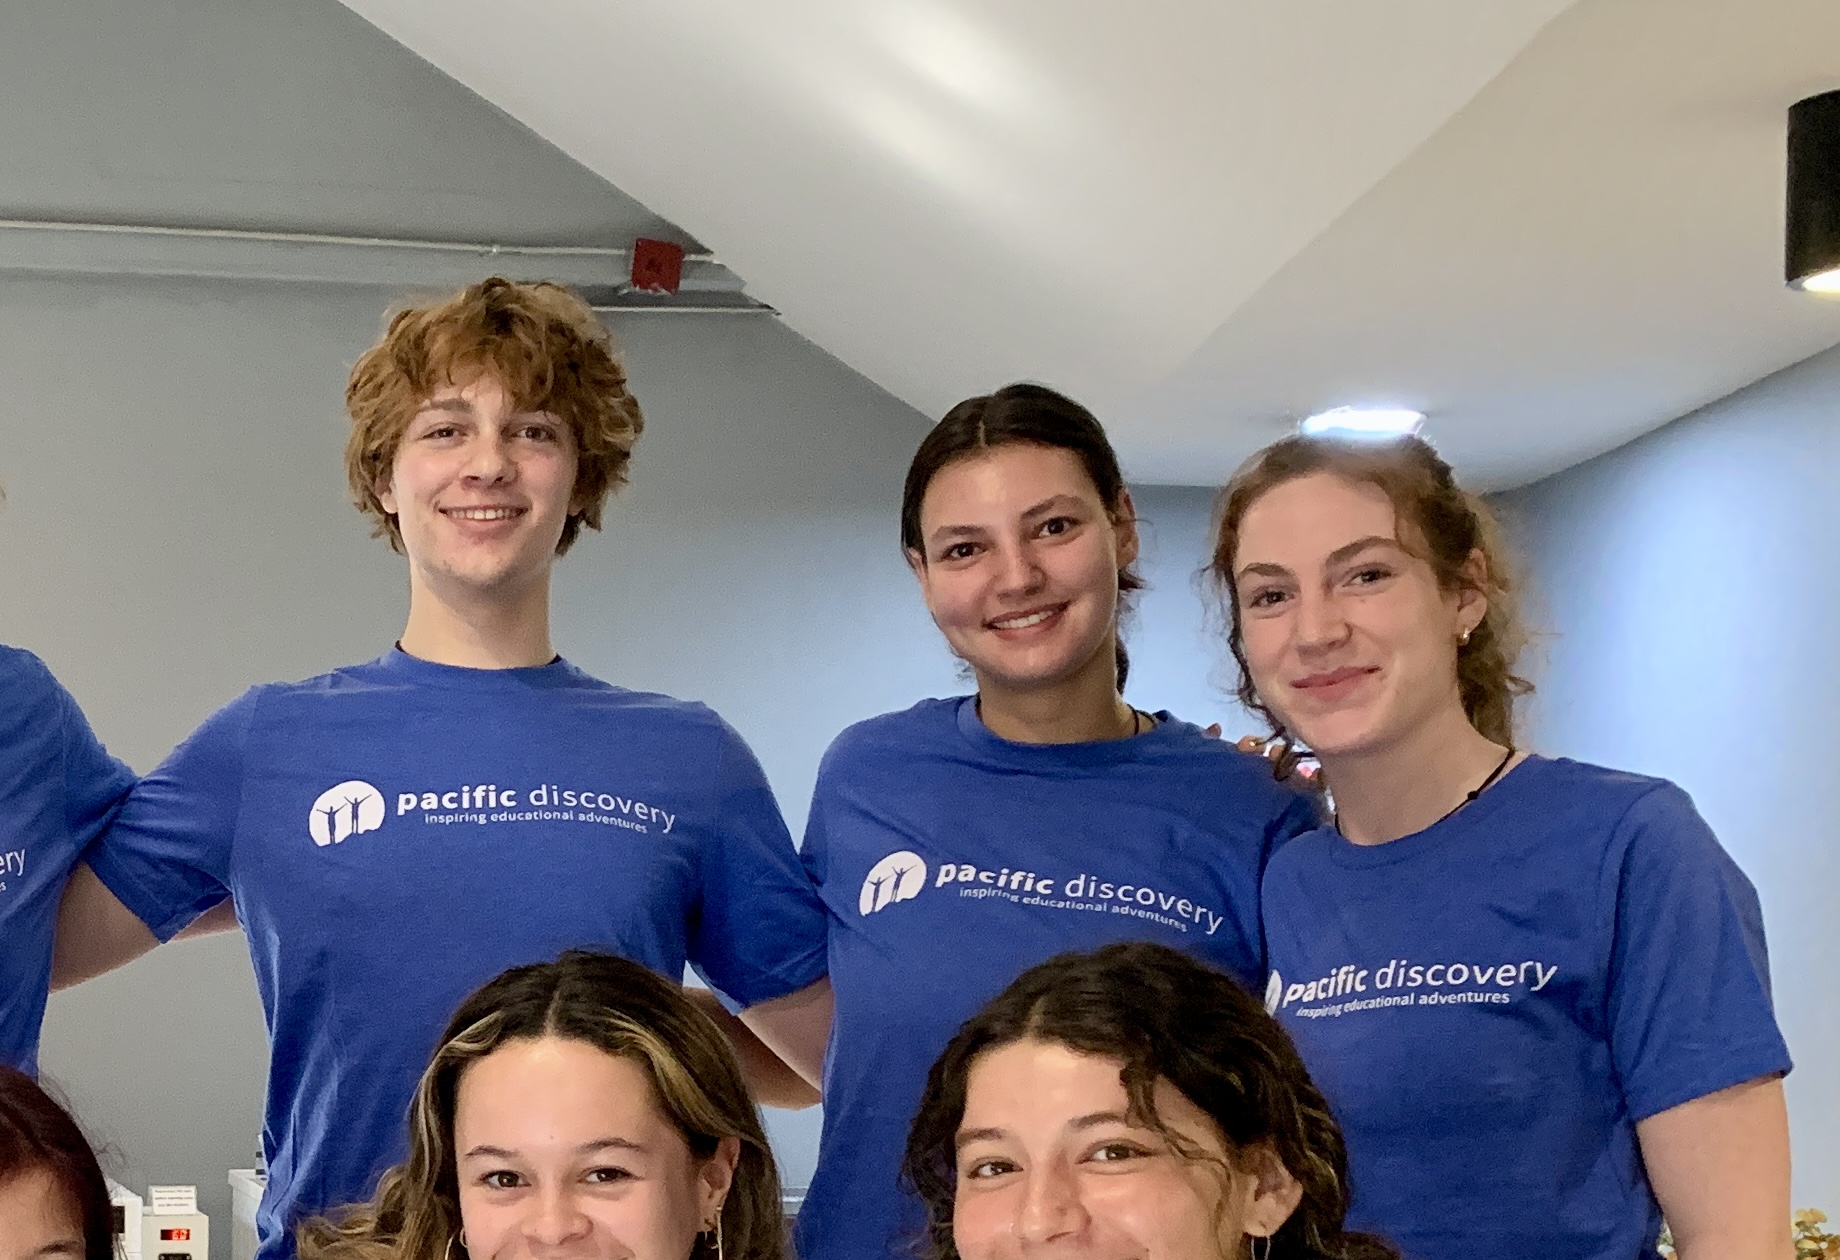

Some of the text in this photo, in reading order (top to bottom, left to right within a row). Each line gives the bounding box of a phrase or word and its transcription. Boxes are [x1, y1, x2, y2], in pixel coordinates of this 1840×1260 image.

[397, 783, 676, 834] pacific discovery
[424, 809, 648, 834] inspiring educational adventures
[935, 863, 1224, 936] pacific discovery
[959, 886, 1188, 932] inspiring educational adventures
[1282, 959, 1558, 1008] pacific discovery
[1296, 991, 1510, 1019] inspiring educational adventures
